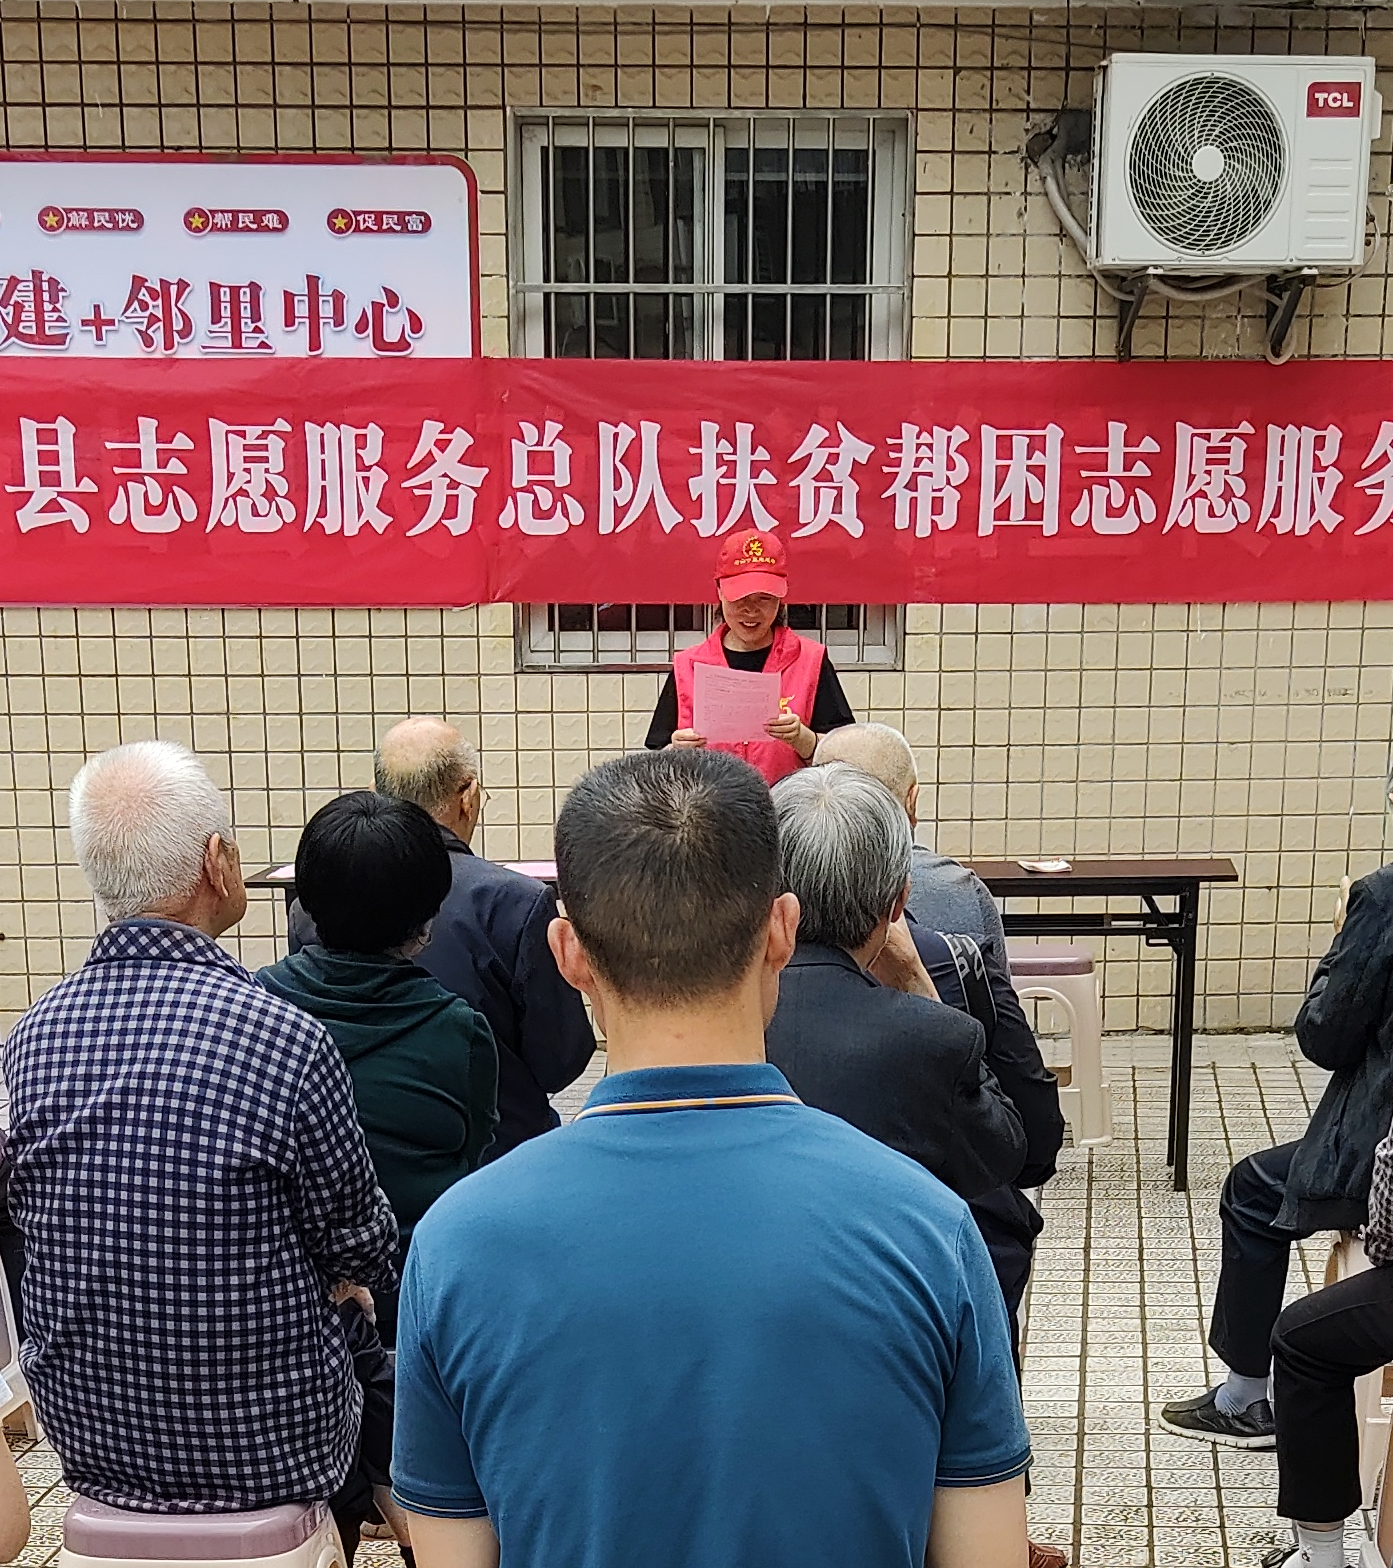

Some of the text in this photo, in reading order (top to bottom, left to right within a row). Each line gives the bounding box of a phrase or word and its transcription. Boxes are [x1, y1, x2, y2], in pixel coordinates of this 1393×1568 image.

[1314, 92, 1354, 108] TCL
[68, 210, 139, 229] 解民忧
[213, 211, 283, 230] 帮民难
[356, 213, 425, 232] 促民富
